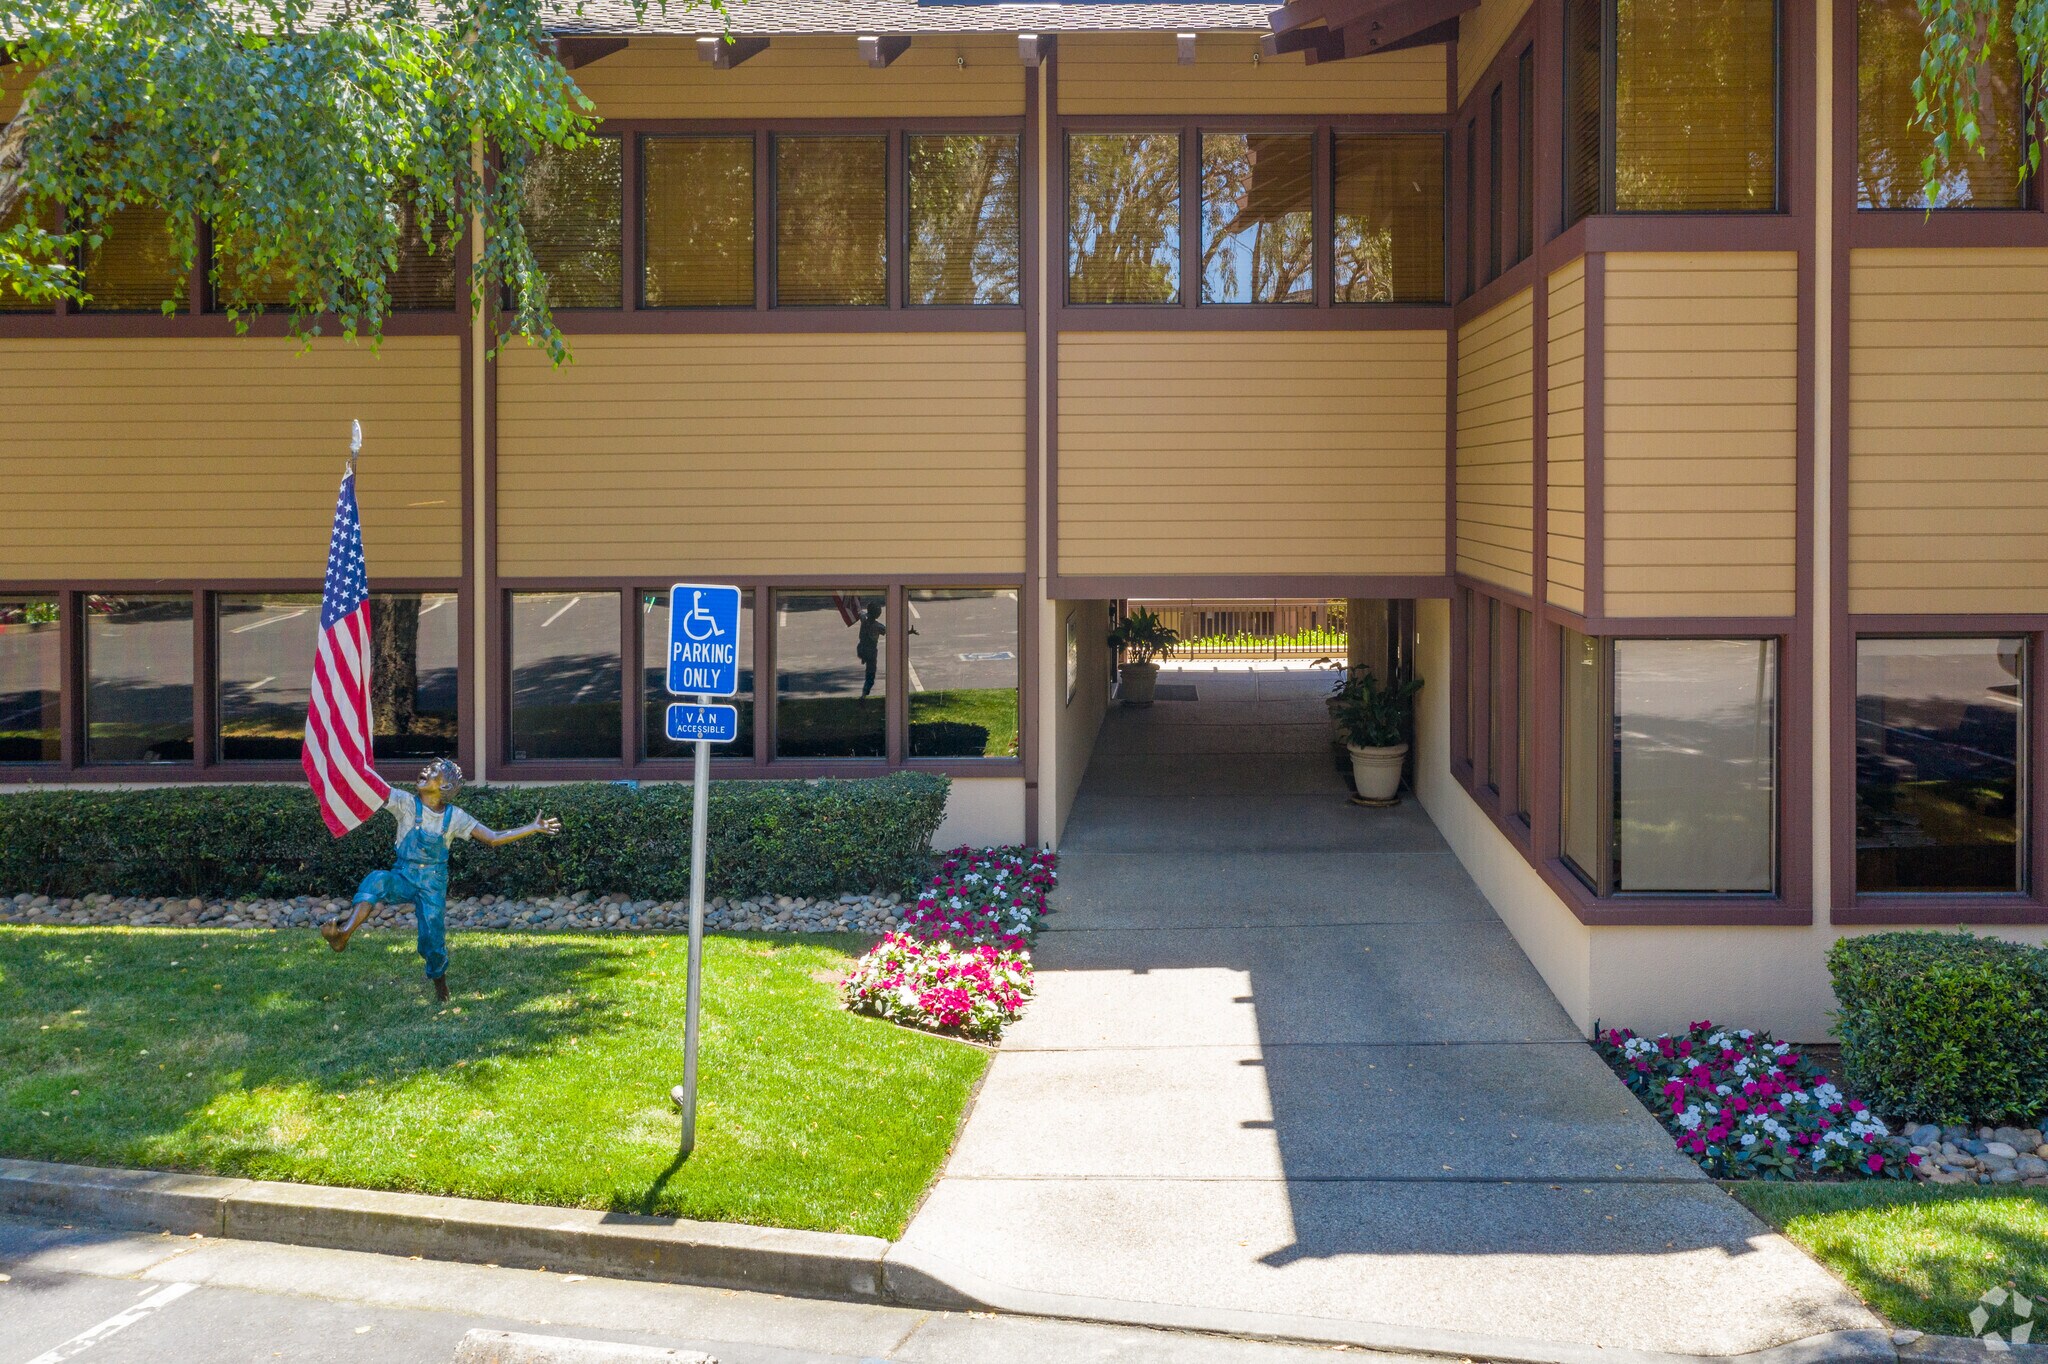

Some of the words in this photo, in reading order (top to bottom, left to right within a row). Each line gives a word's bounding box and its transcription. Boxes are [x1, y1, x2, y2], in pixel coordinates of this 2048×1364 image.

[674, 642, 733, 664] PARKING
[684, 667, 720, 688] ONLY
[686, 713, 717, 724] VAN
[677, 725, 725, 733] ACCESSIBLE
